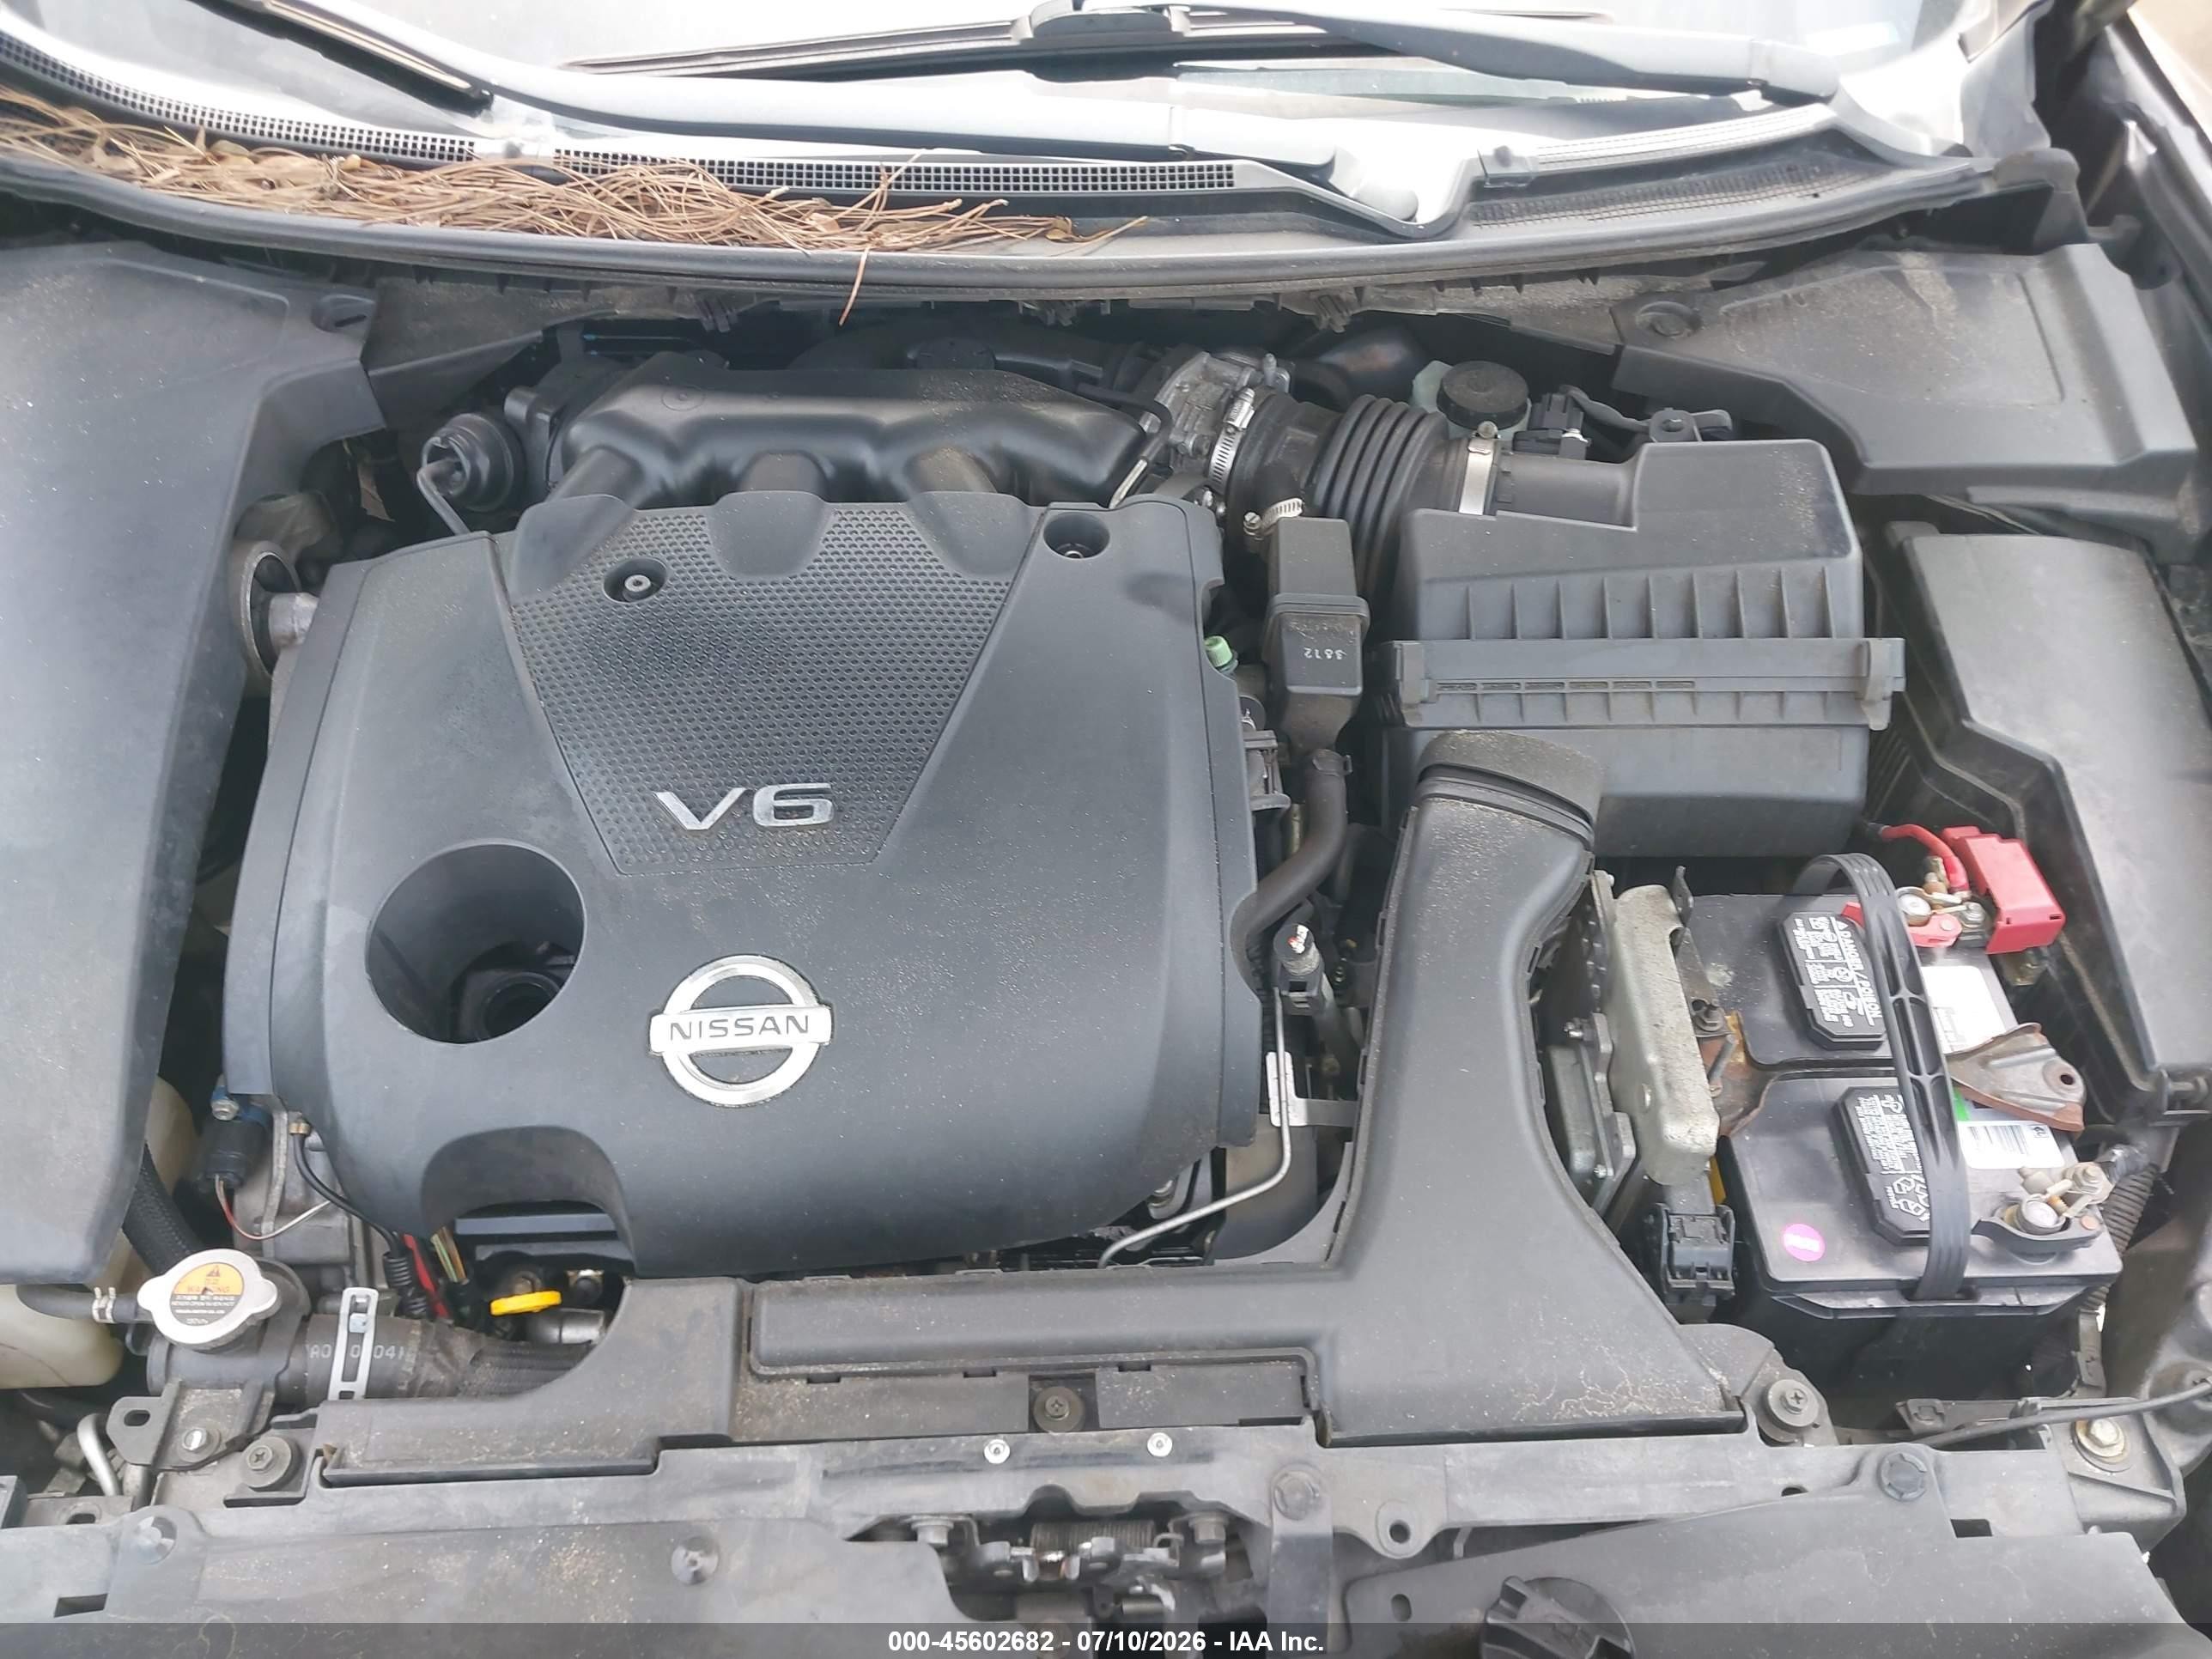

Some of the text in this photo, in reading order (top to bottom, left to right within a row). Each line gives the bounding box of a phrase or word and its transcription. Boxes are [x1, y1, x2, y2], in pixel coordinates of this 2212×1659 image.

[653, 782, 835, 831] V6
[1839, 930, 1864, 970] DANGER
[1857, 980, 1883, 1018] POISON
[669, 1014, 810, 1042] NISSAN
